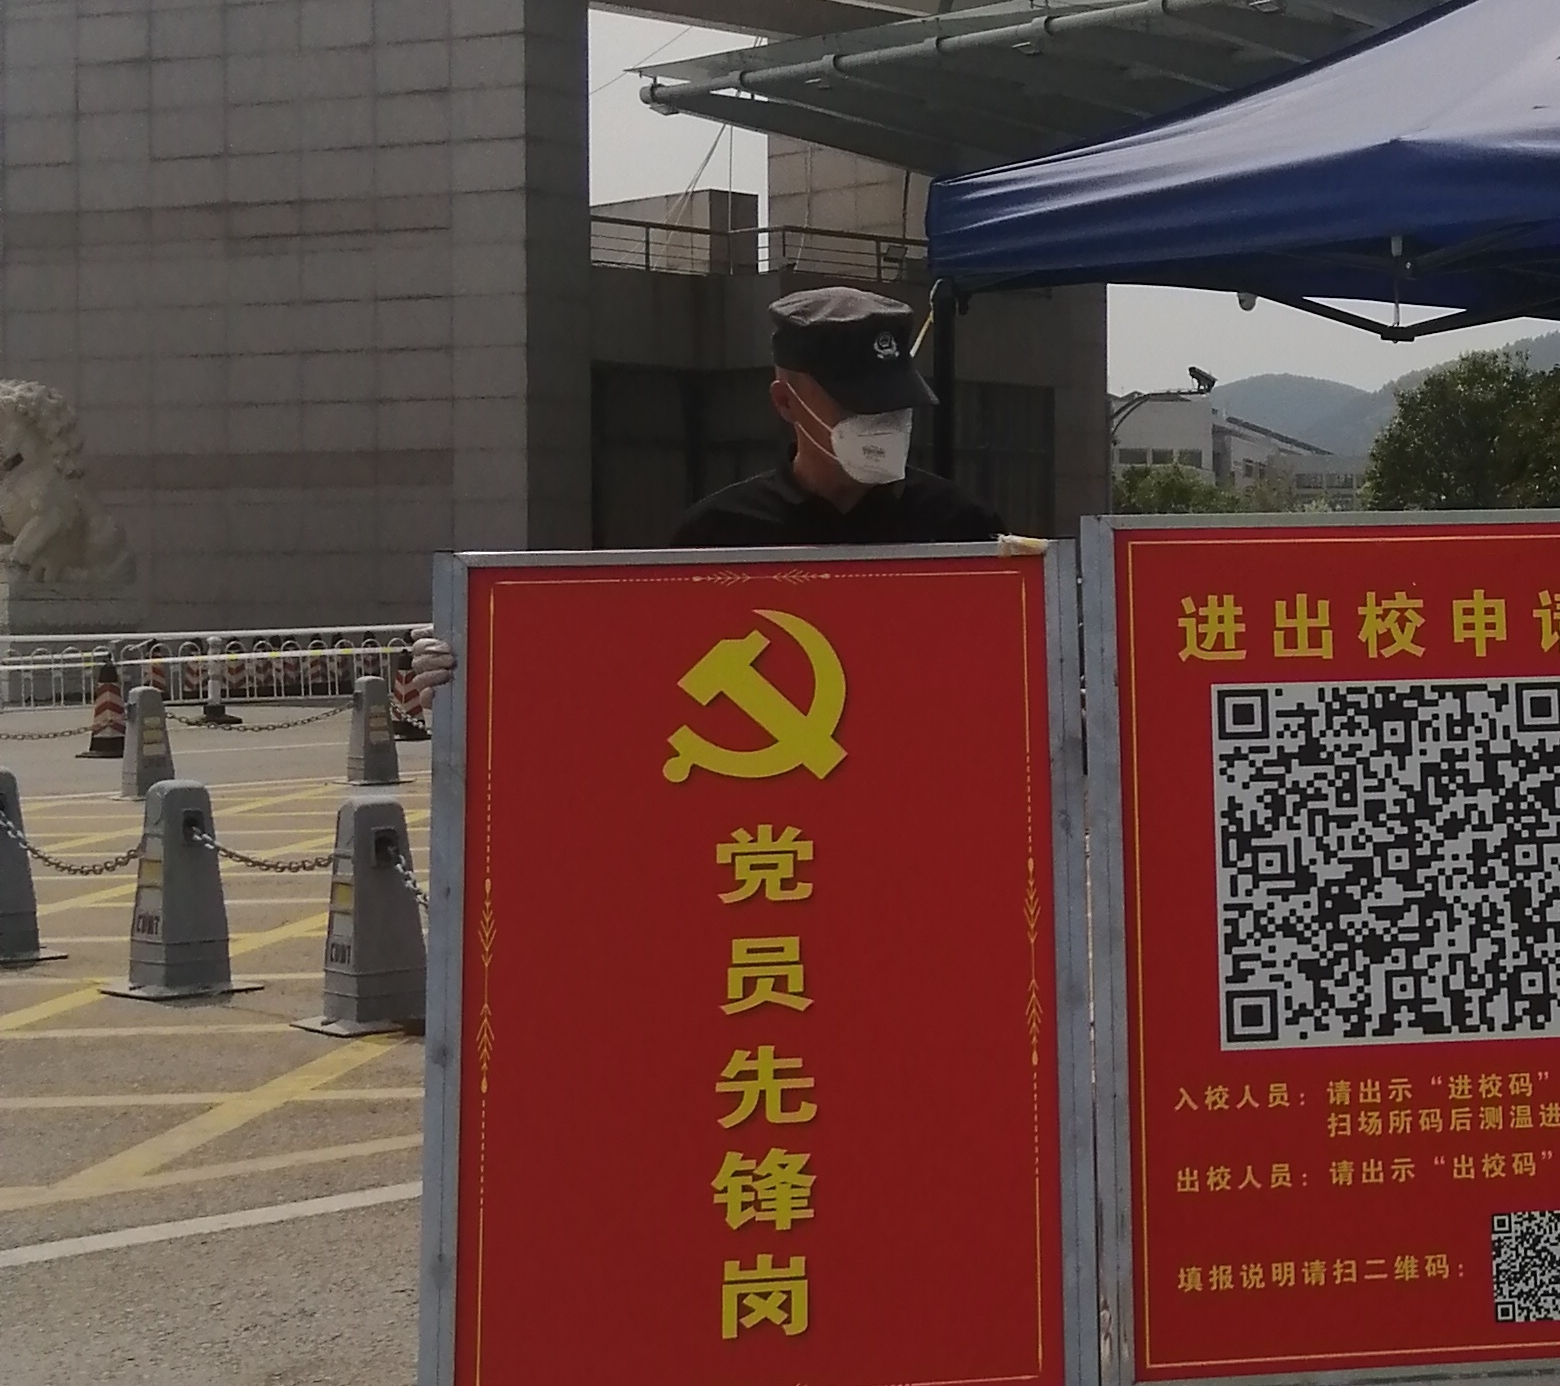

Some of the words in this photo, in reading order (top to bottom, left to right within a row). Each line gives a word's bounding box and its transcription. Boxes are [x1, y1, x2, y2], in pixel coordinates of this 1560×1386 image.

[713, 824, 817, 1340] 党员先锋岗
[1177, 1254, 1464, 1292] 填报说明请扫二维码：
